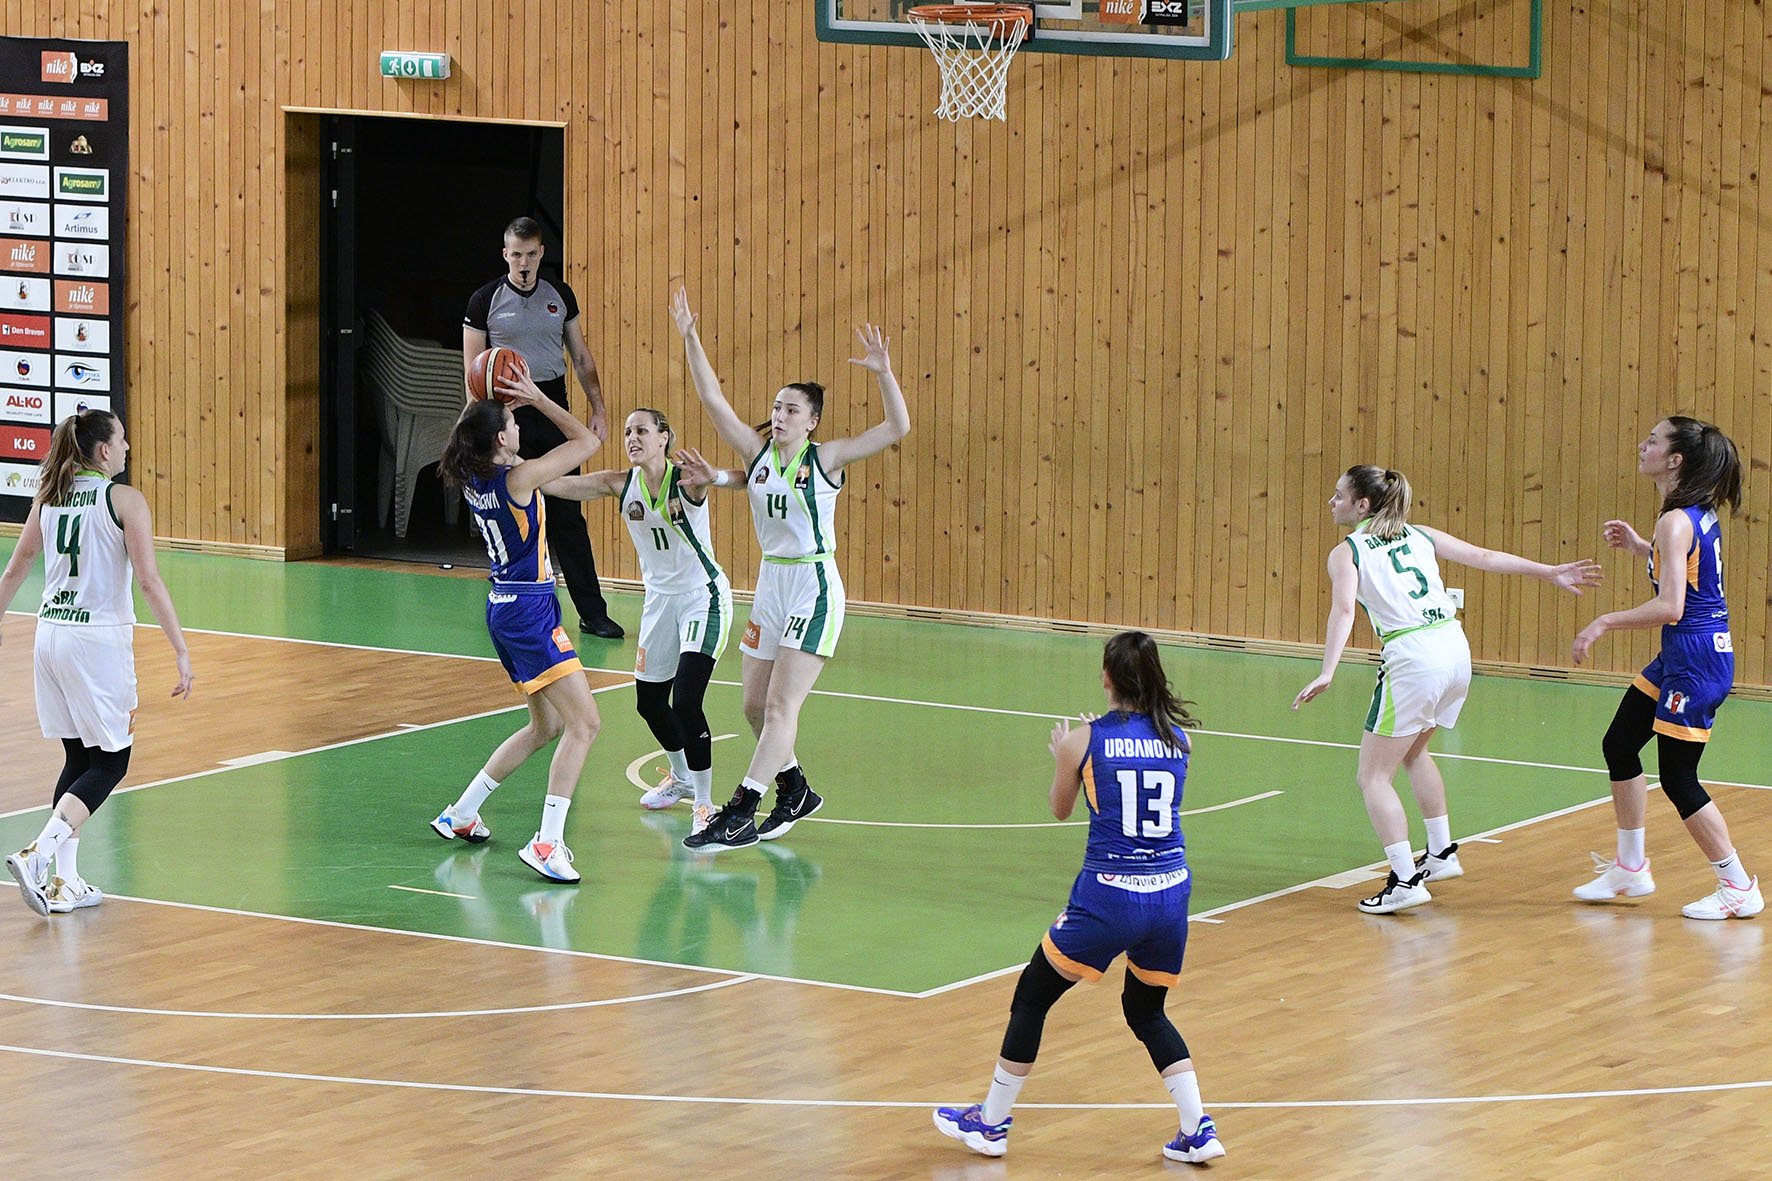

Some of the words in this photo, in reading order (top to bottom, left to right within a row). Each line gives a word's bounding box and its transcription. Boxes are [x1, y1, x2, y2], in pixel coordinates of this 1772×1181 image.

[46, 58, 68, 74] niké
[64, 224, 98, 234] Artimus
[11, 243, 36, 261] niké
[69, 285, 94, 303] niké
[6, 395, 43, 409] AL-KO
[14, 438, 36, 451] KJG
[766, 493, 787, 519] 14
[56, 513, 81, 577] 4
[651, 527, 669, 550] 11
[1388, 543, 1429, 599] 5
[686, 620, 700, 642] 11
[784, 616, 806, 640] 14
[1116, 770, 1175, 838] 13
